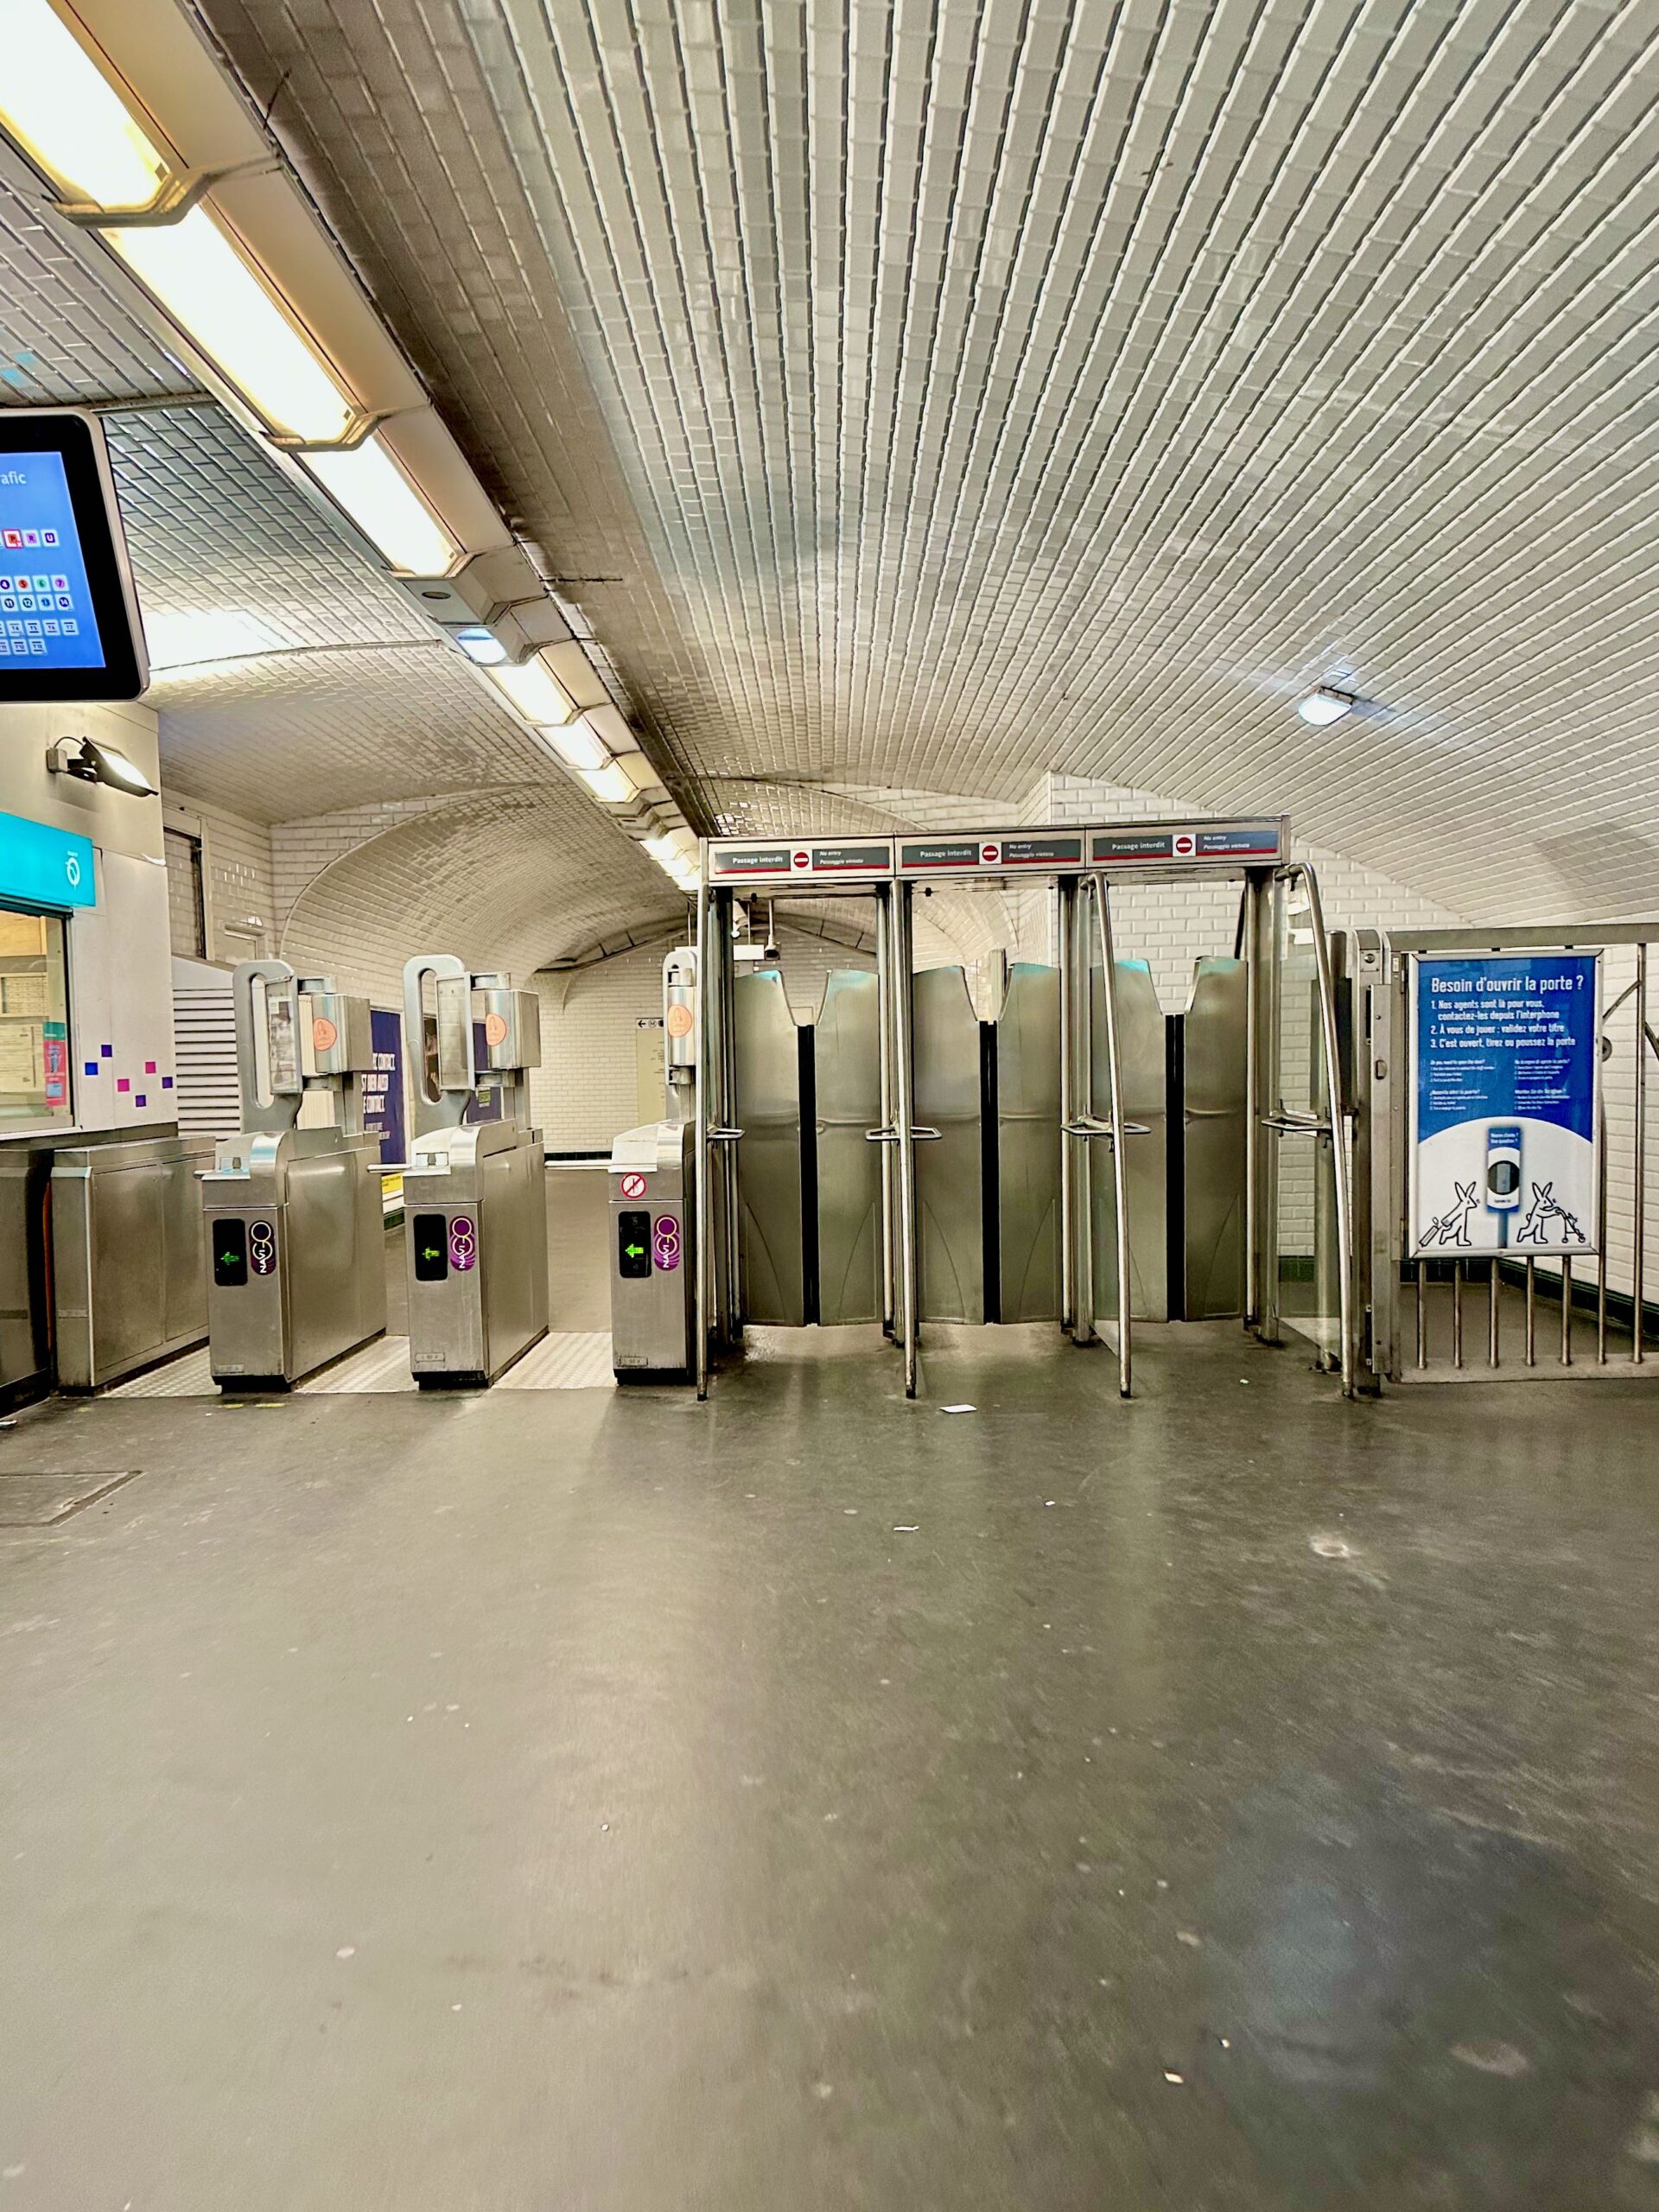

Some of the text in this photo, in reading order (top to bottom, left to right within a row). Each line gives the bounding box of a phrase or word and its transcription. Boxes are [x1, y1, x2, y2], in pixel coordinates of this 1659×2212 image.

[0, 471, 27, 485] afic
[732, 857, 759, 865] Passage
[1431, 975, 1584, 995] Besoin d'ouvrir la porte ?
[1431, 1000, 1437, 1010] 1.
[1438, 1000, 1452, 1009] Nos
[1454, 999, 1479, 1011] agents
[1480, 999, 1497, 1009] sont
[1507, 1001, 1525, 1010] pour
[1438, 1010, 1560, 1022] contactez-les depuis l'interphone
[1430, 1025, 1438, 1035] 2.
[1440, 1023, 1446, 1035] À
[1465, 1024, 1475, 1034] de
[1475, 1025, 1496, 1036] jouer
[1501, 1023, 1527, 1033] validez
[1528, 1023, 1547, 1033] votre
[1548, 1023, 1565, 1033] titre
[1430, 1039, 1438, 1048] 3.
[1439, 1039, 1458, 1048] C'est
[1486, 1037, 1503, 1047] tirez
[1516, 1039, 1546, 1049] poussez
[1547, 1036, 1554, 1046] la
[1555, 1036, 1576, 1048] porte
